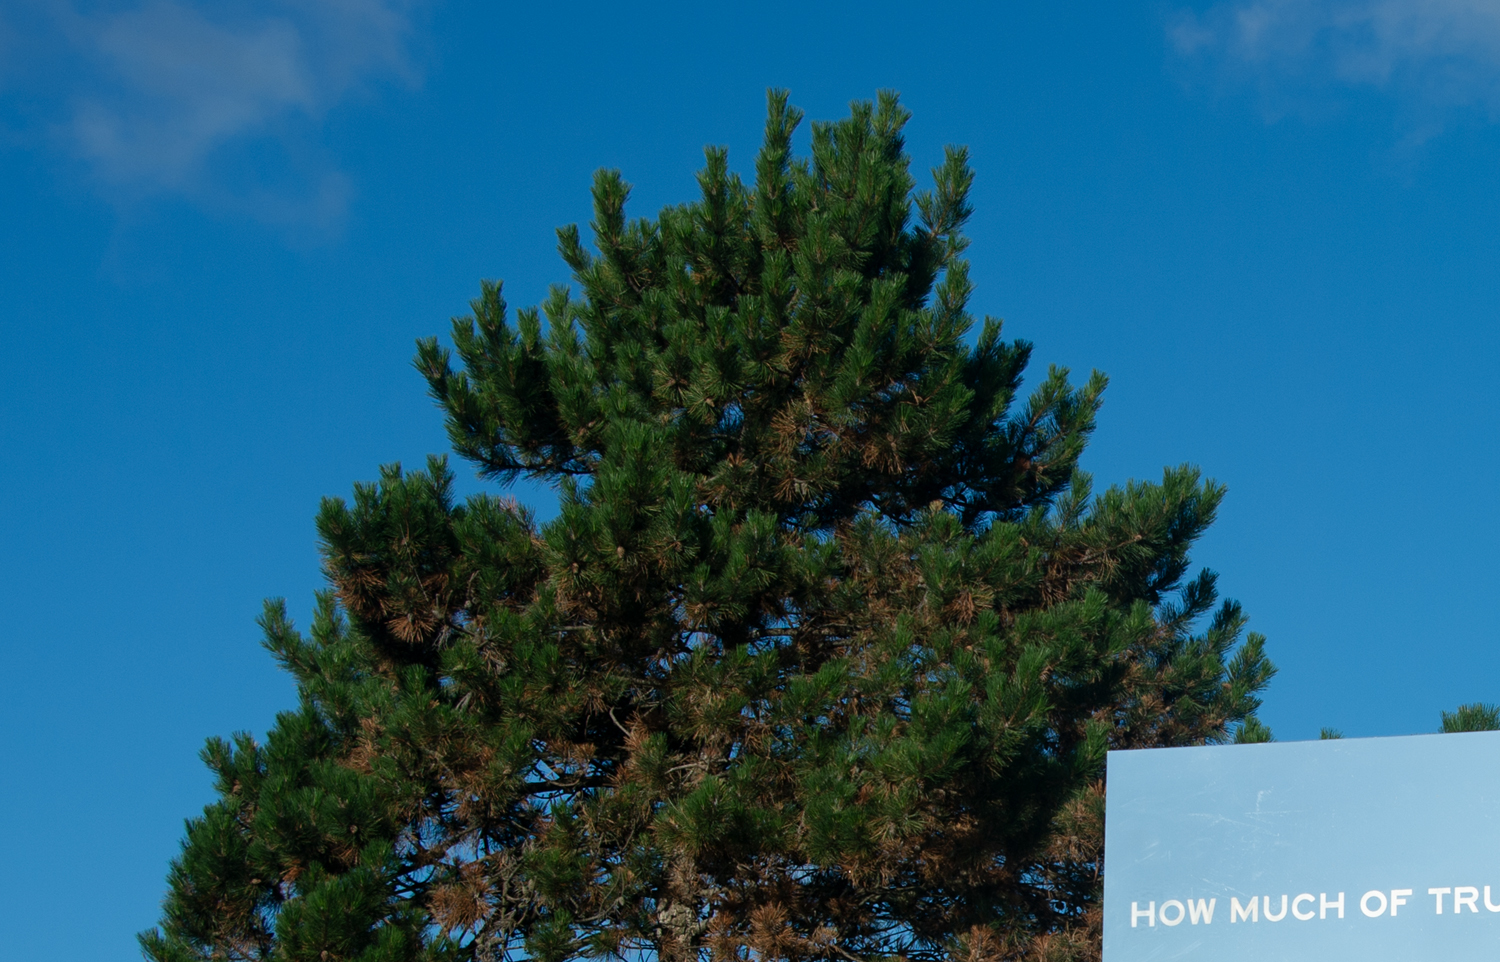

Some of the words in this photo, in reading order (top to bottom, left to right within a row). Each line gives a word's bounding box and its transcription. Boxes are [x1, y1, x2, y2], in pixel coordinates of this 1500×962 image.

[1130, 897, 1217, 929] HOW
[1230, 891, 1345, 924] MUCH
[1359, 888, 1414, 918] OF
